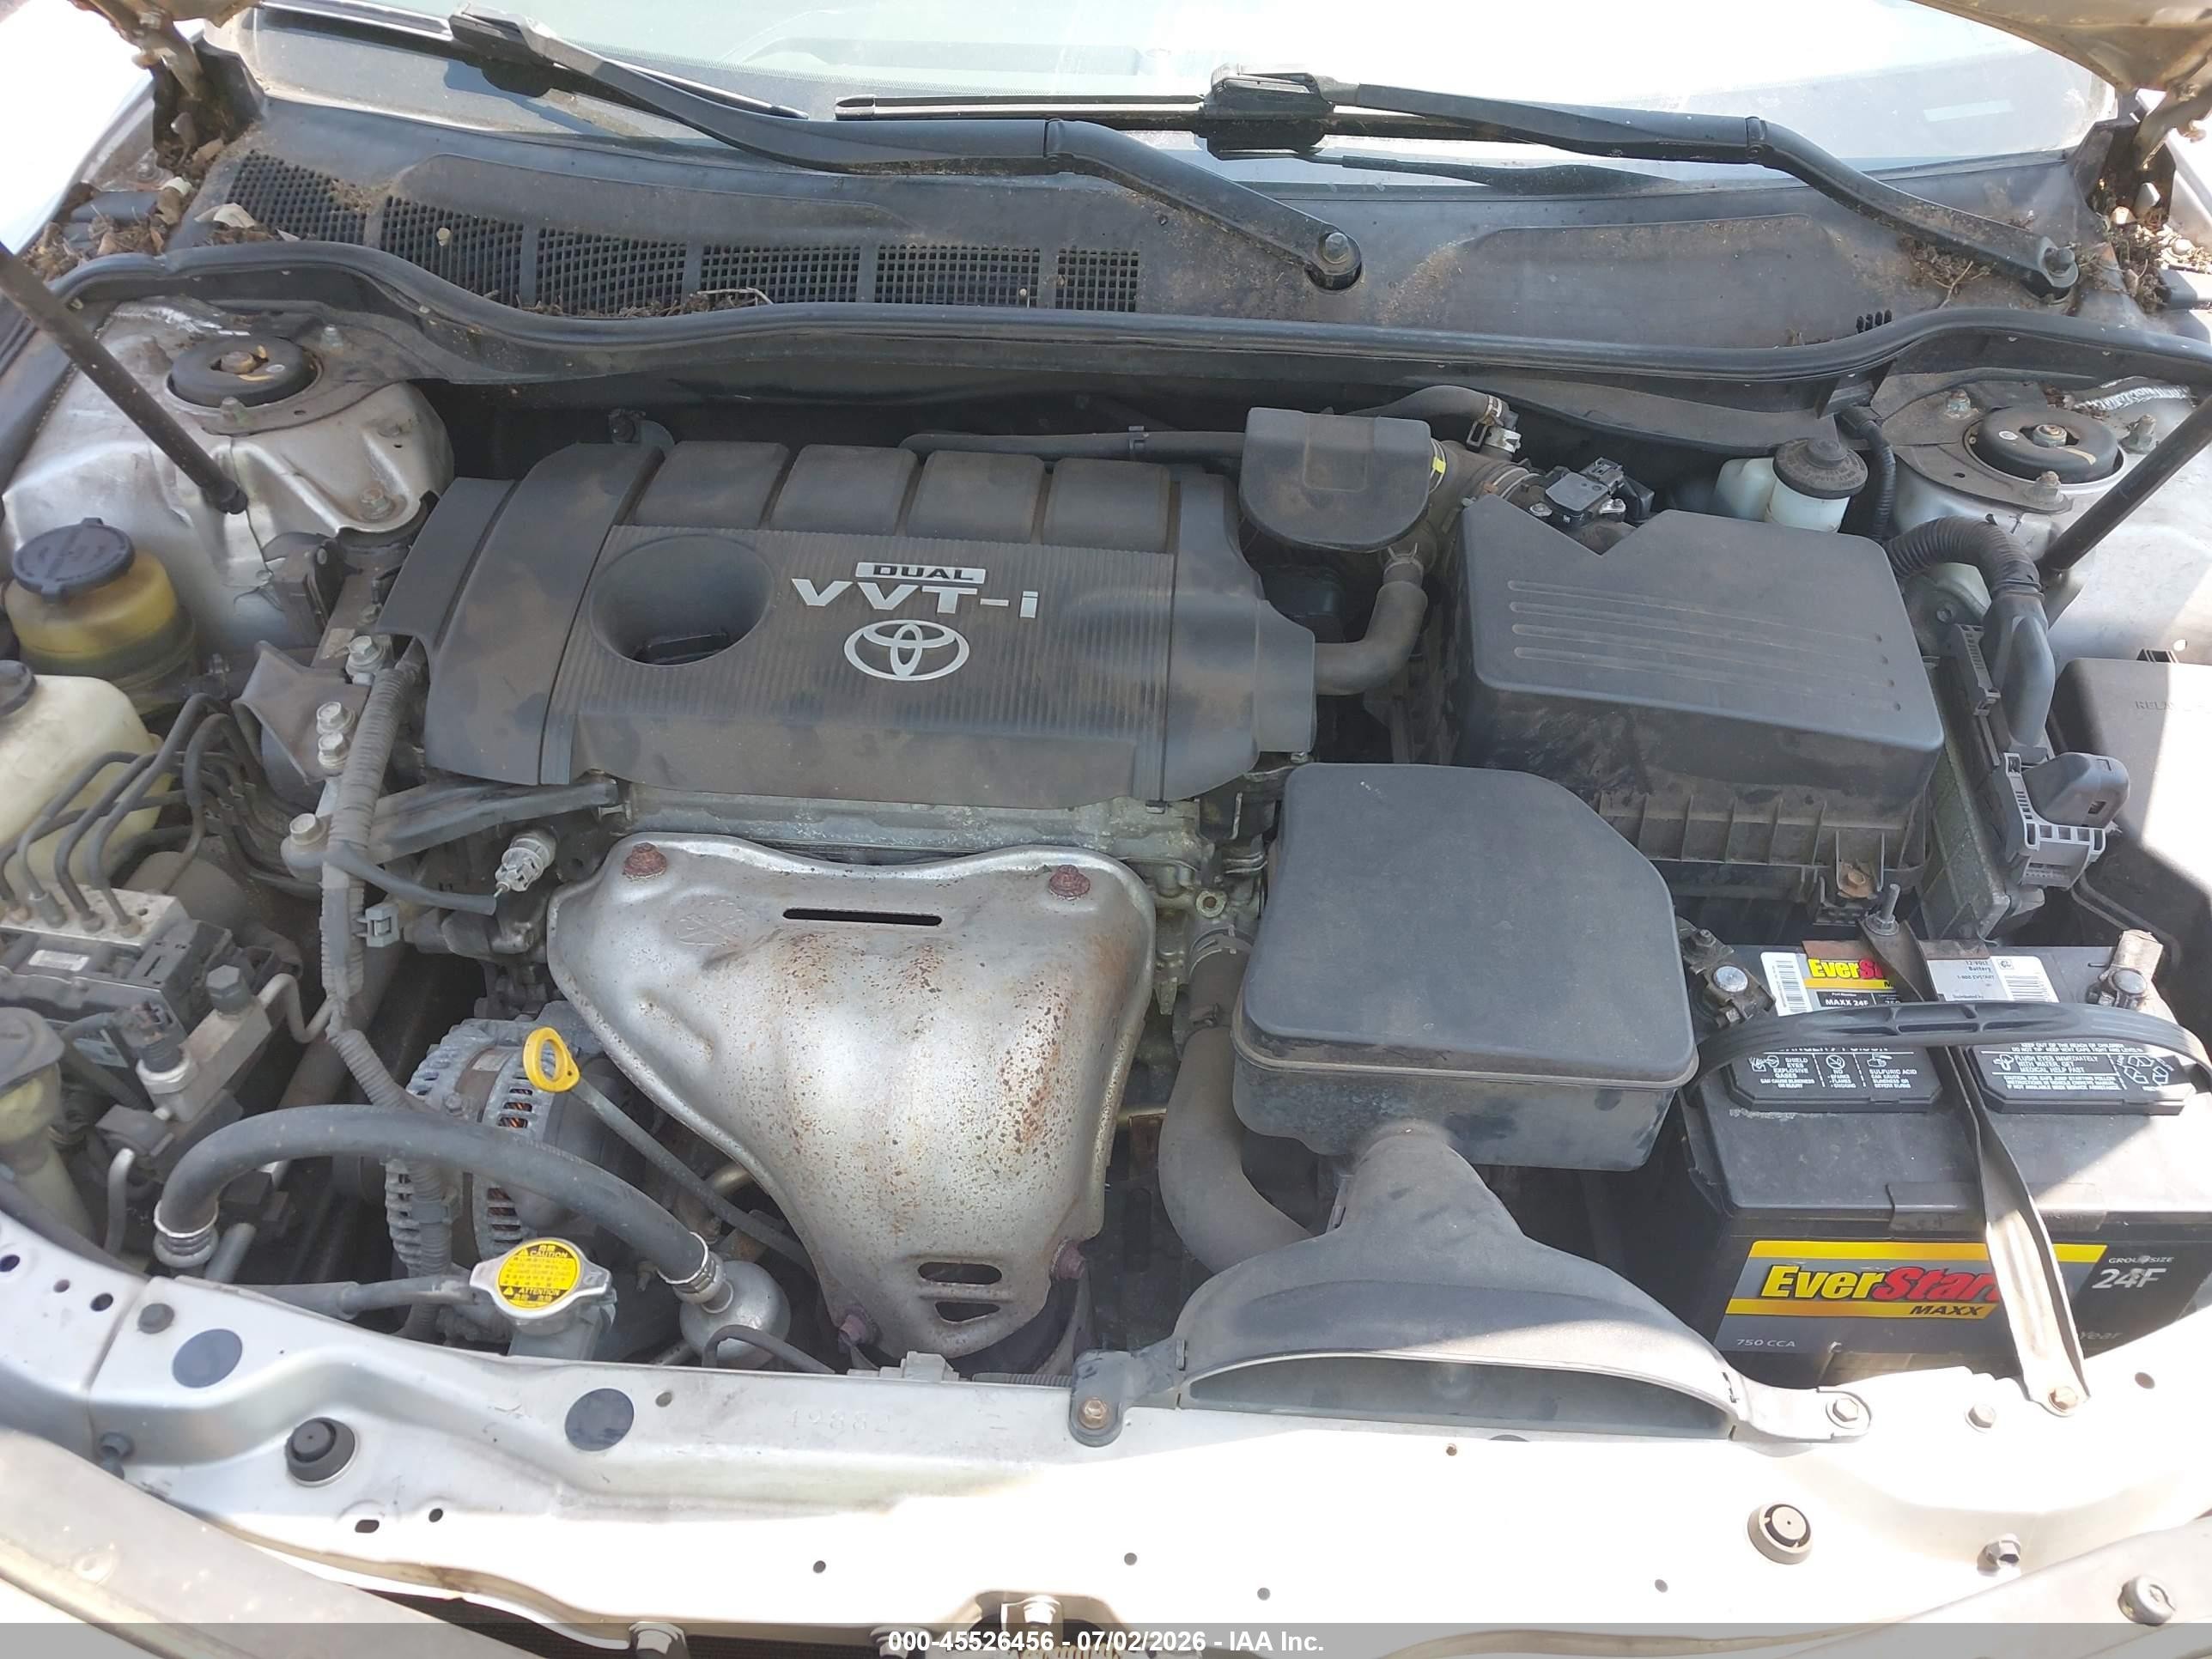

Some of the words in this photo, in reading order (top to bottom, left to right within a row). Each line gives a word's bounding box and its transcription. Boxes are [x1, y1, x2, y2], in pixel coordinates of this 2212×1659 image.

[872, 564, 974, 580] DUAL
[791, 578, 1039, 618] VVT-i
[1808, 957, 1883, 979] EverSt
[2092, 1267, 2167, 1289] 24F
[1910, 1304, 1984, 1316] MAXX
[1736, 1338, 1764, 1347] 750
[1766, 1340, 1796, 1348] CCA
